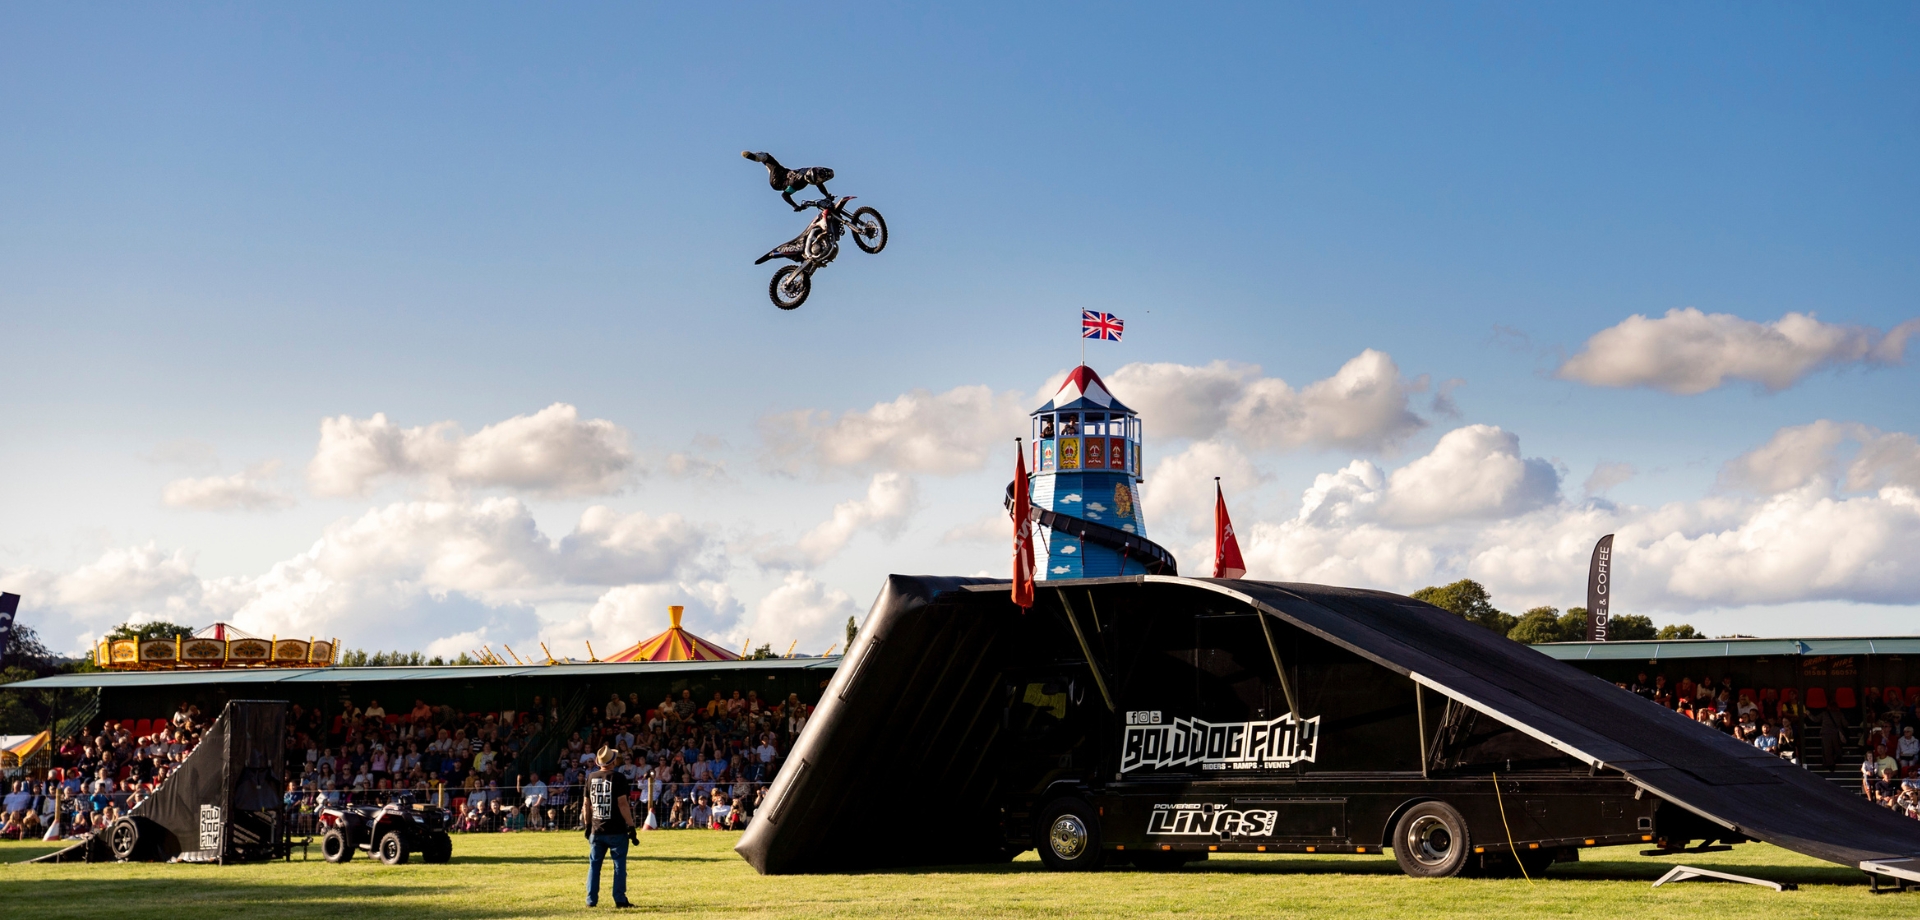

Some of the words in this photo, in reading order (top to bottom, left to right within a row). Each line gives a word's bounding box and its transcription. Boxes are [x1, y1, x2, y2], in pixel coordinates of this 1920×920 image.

[1597, 546, 1610, 595] COFFEE
[1595, 608, 1606, 642] JUICE
[1832, 656, 1854, 668] HIRE
[1246, 712, 1320, 764] FMX
